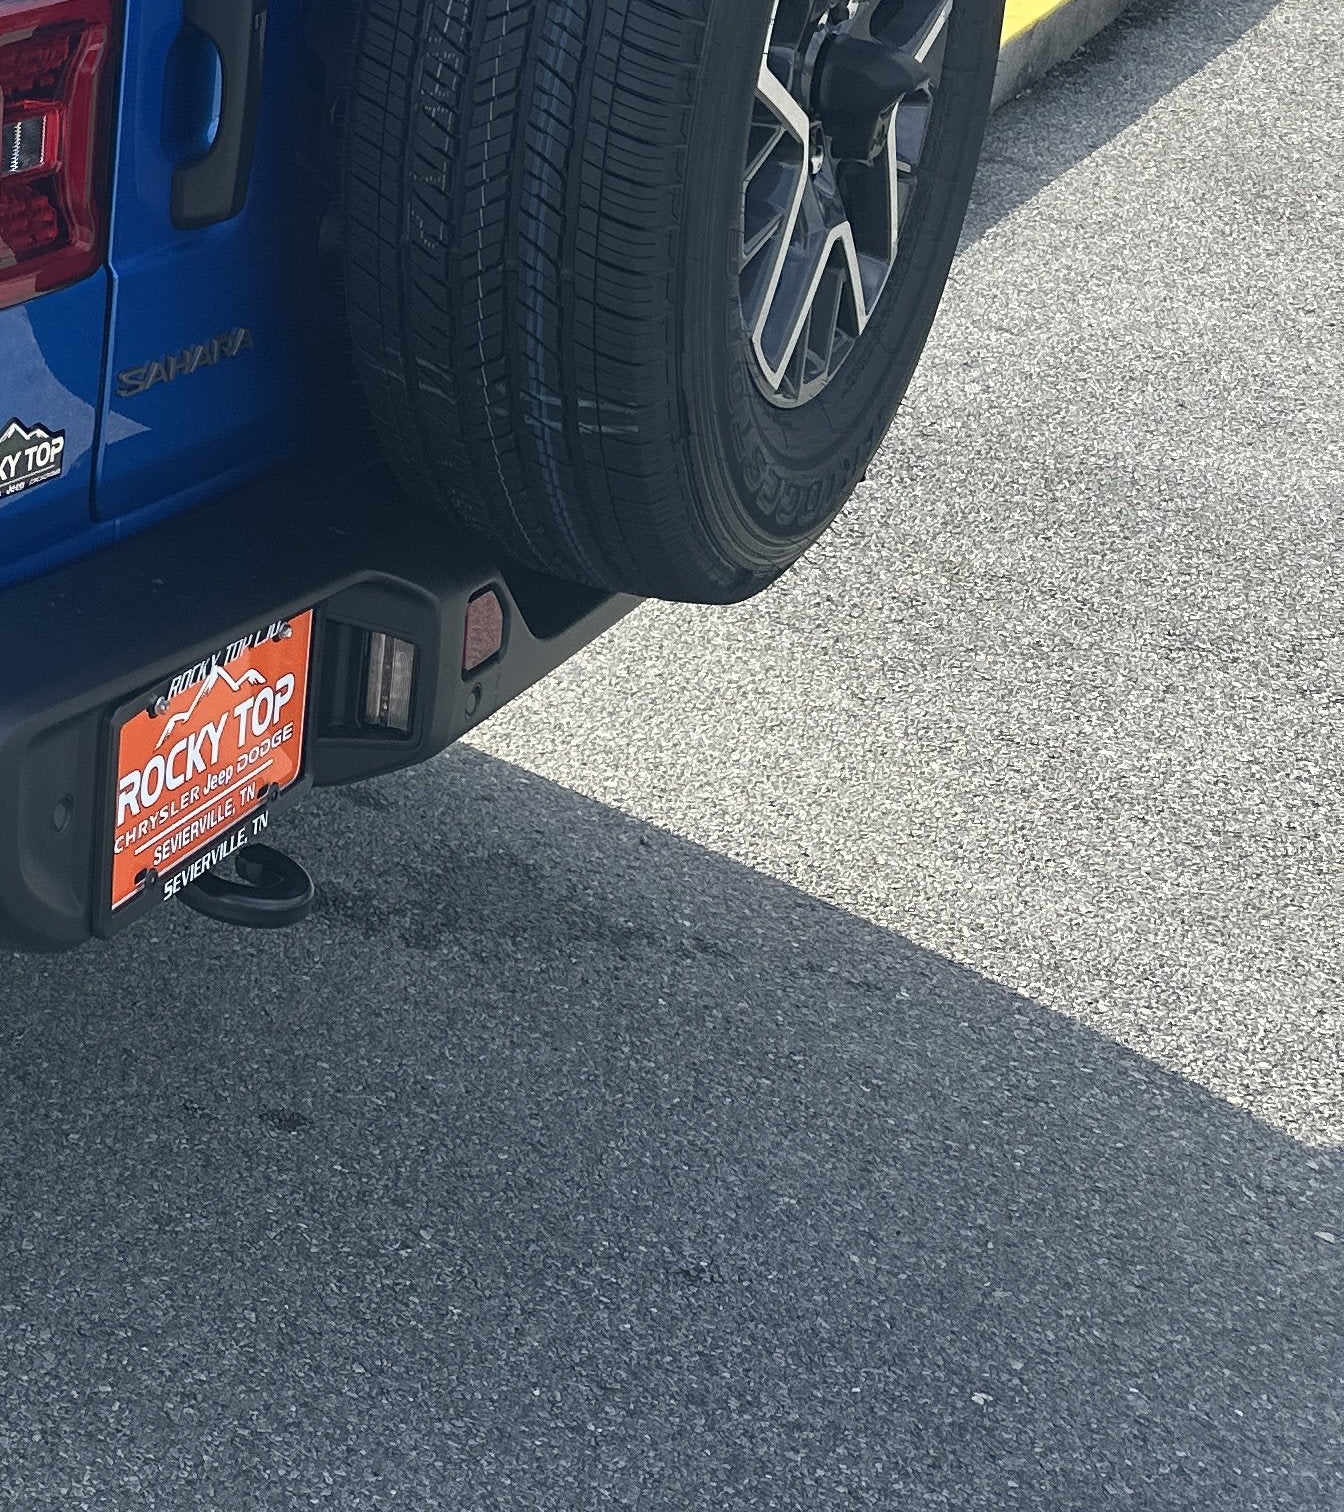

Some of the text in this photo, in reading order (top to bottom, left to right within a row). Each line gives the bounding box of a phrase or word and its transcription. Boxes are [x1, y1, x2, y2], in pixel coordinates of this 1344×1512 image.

[116, 327, 252, 398] SAHARA
[23, 436, 65, 472] TOP
[167, 651, 222, 701] ROCKY
[113, 721, 294, 855] CHRYSLER Jeep DODGE
[116, 672, 295, 827] ROCKY TOP
[153, 781, 256, 866] SEVIERVILLE, TN
[163, 810, 269, 902] SEVIERVILLE, TN
